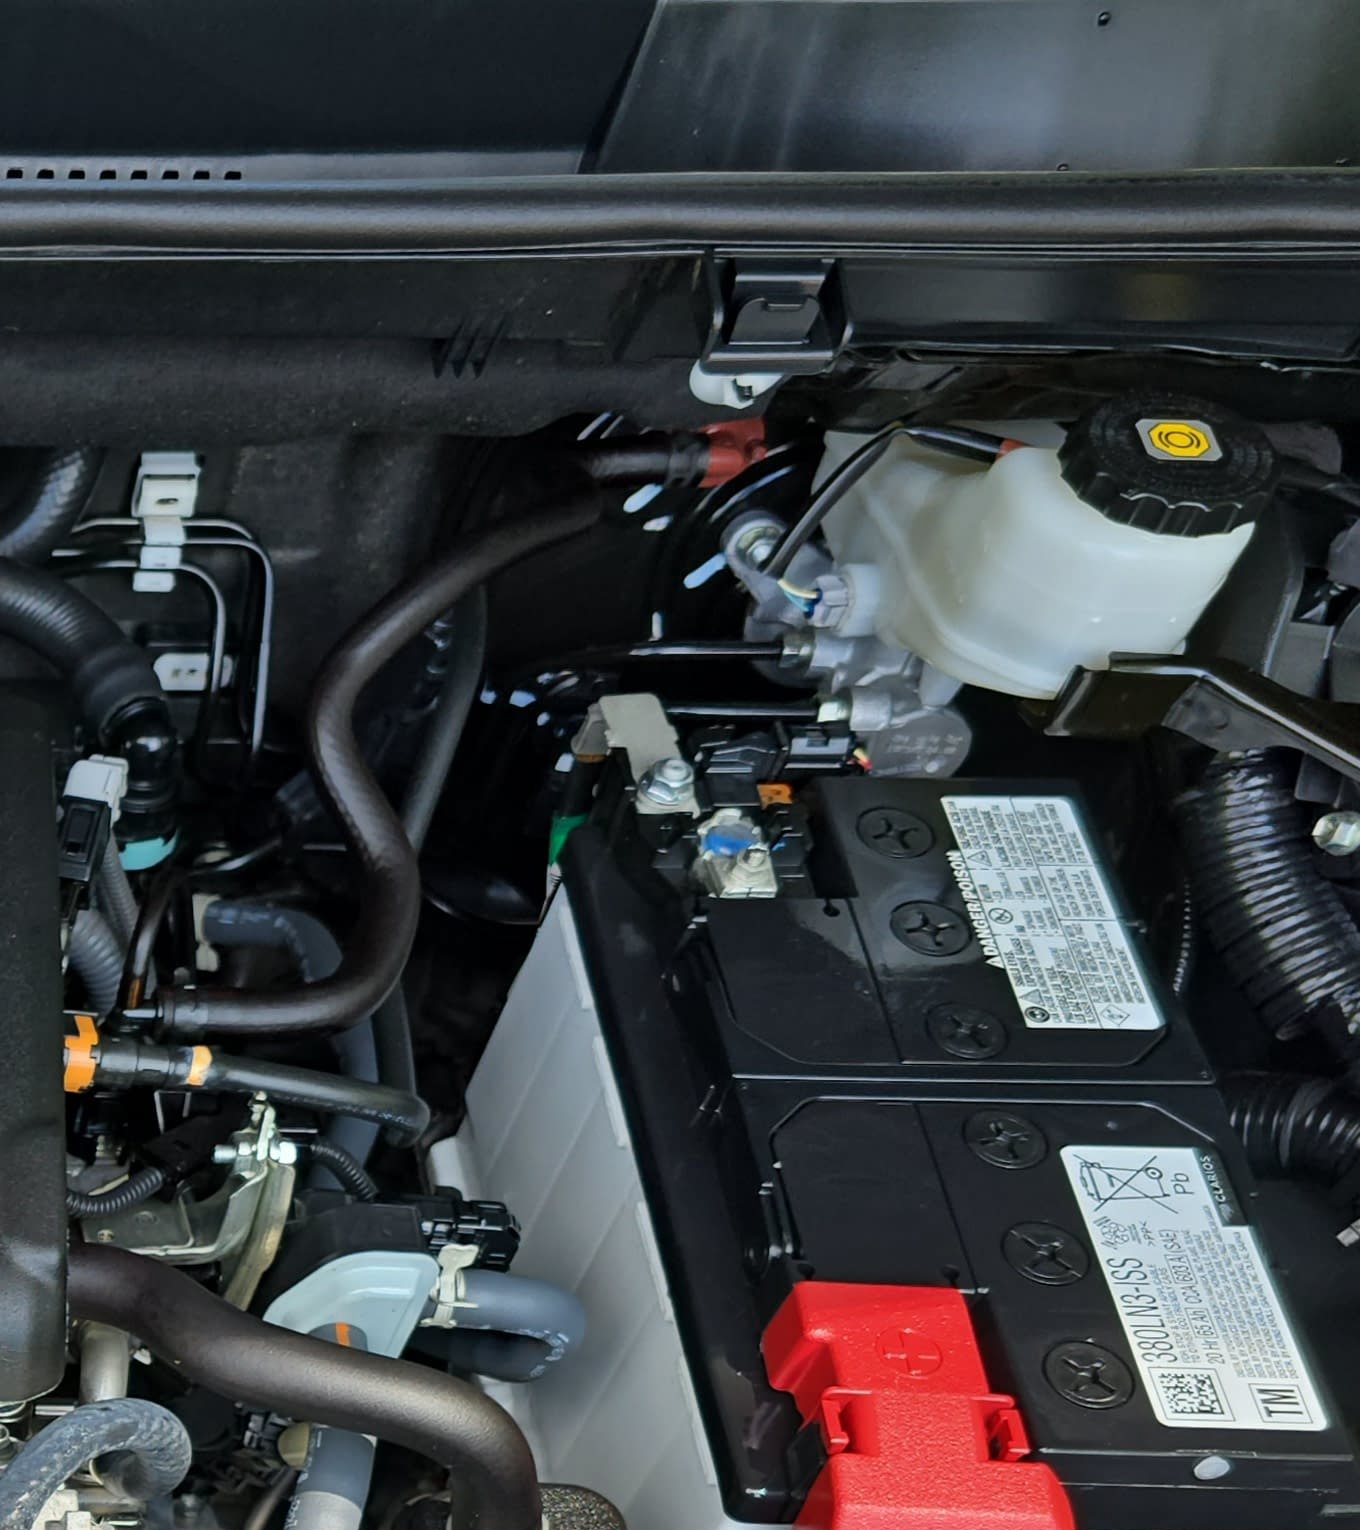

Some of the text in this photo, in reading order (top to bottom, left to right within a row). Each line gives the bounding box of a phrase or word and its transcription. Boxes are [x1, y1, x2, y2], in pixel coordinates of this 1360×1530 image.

[947, 851, 1001, 957] DANGER/POISON
[1172, 1172, 1194, 1196] Pb
[1201, 1155, 1227, 1205] CLARIOS
[1156, 1229, 1183, 1252] (SAE)
[1170, 1265, 1194, 1281] 603
[1178, 1285, 1203, 1303] CCA
[1104, 1257, 1178, 1362] 380LN3-ISS
[1187, 1310, 1209, 1322] Ah
[1193, 1324, 1214, 1335] 65
[1199, 1339, 1219, 1348] Hr
[1204, 1352, 1225, 1363] 20
[1259, 1387, 1304, 1419] TM
